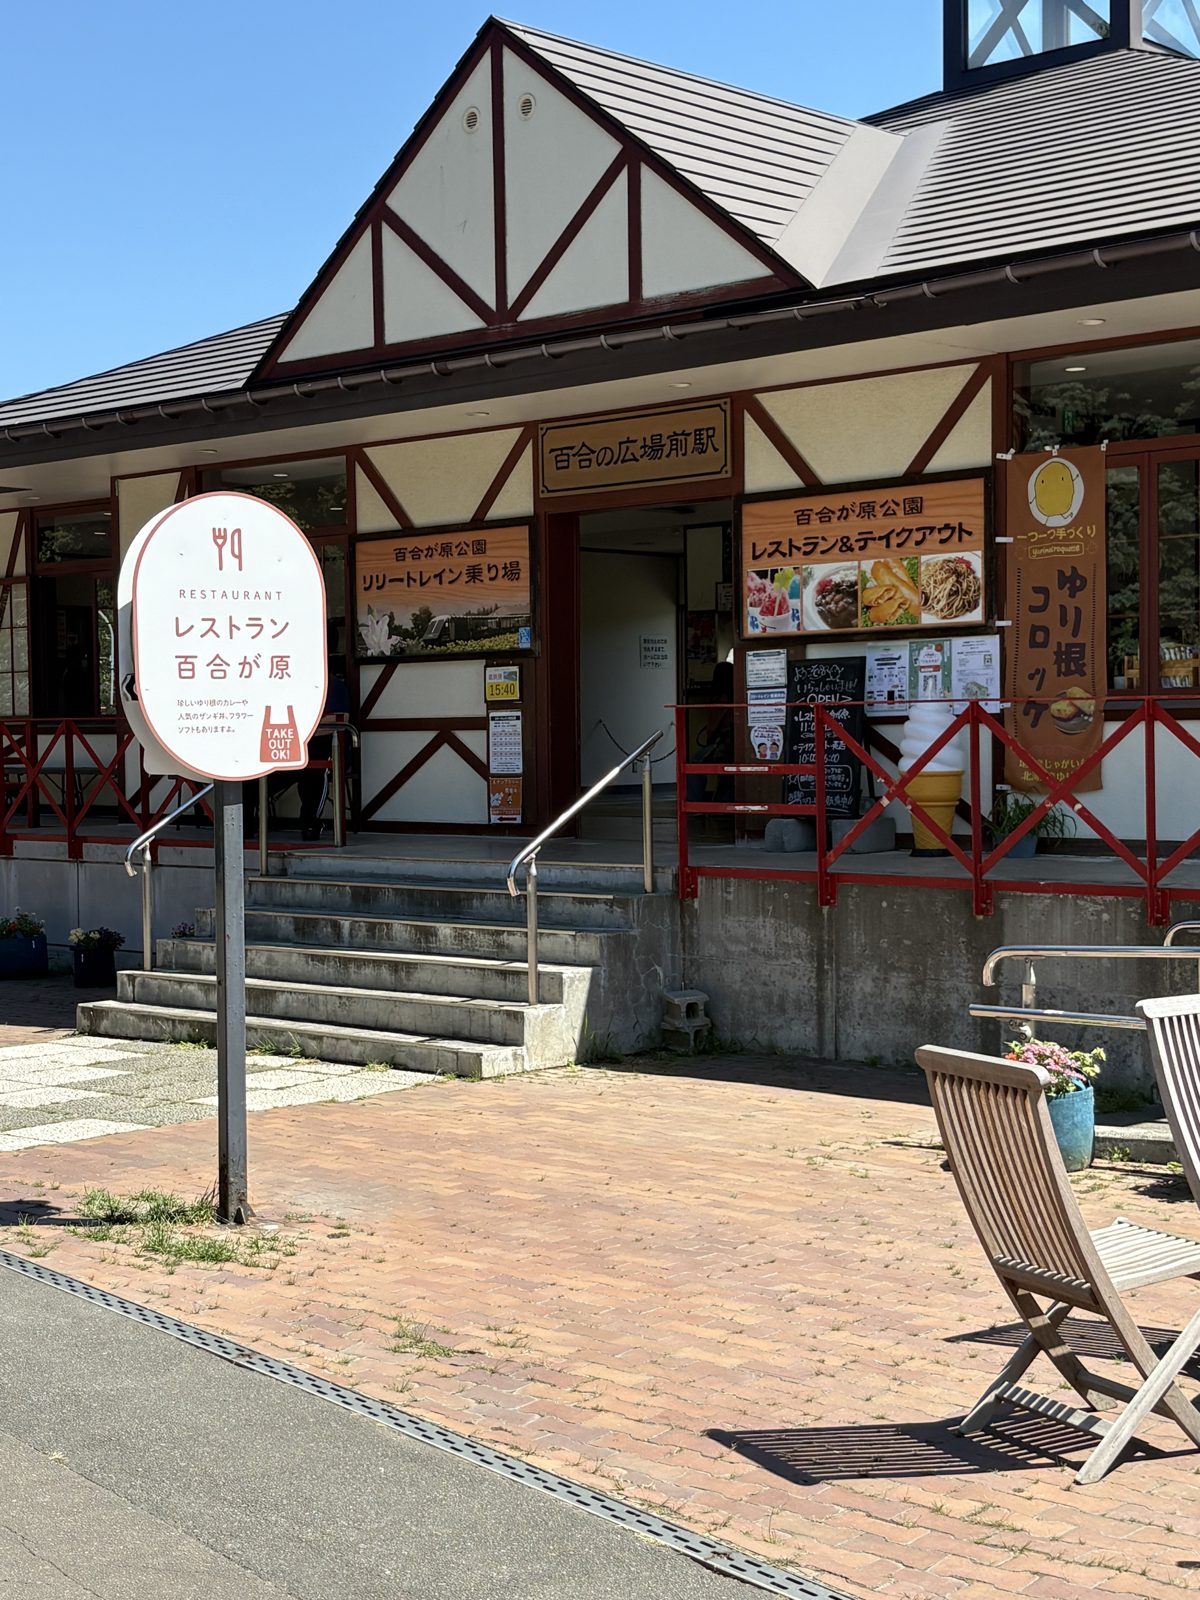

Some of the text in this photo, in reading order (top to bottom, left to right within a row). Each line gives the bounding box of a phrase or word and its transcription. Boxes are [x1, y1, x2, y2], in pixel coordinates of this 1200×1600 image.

[548, 426, 720, 471] 百合の広場前駅
[793, 496, 923, 526] 百合が原公園
[393, 538, 487, 562] 百合が原公園
[751, 522, 973, 561] レストラン&テイクアウト
[362, 561, 521, 592] リリートレイン乗り場
[179, 589, 283, 601] RESTAURANT
[175, 615, 290, 640] レストラン
[1053, 565, 1088, 677] ゆり根
[175, 653, 291, 680] 百合が原
[1023, 586, 1050, 728] コロッケ
[489, 683, 515, 696] 15:40
[177, 699, 249, 707] 珍しいゆり根のカレーや
[177, 712, 254, 721] 人気のザンギ丼、フラワー
[178, 725, 236, 734] ソフトもありますよ。
[265, 728, 294, 738] TAKE
[268, 739, 292, 749] OUT
